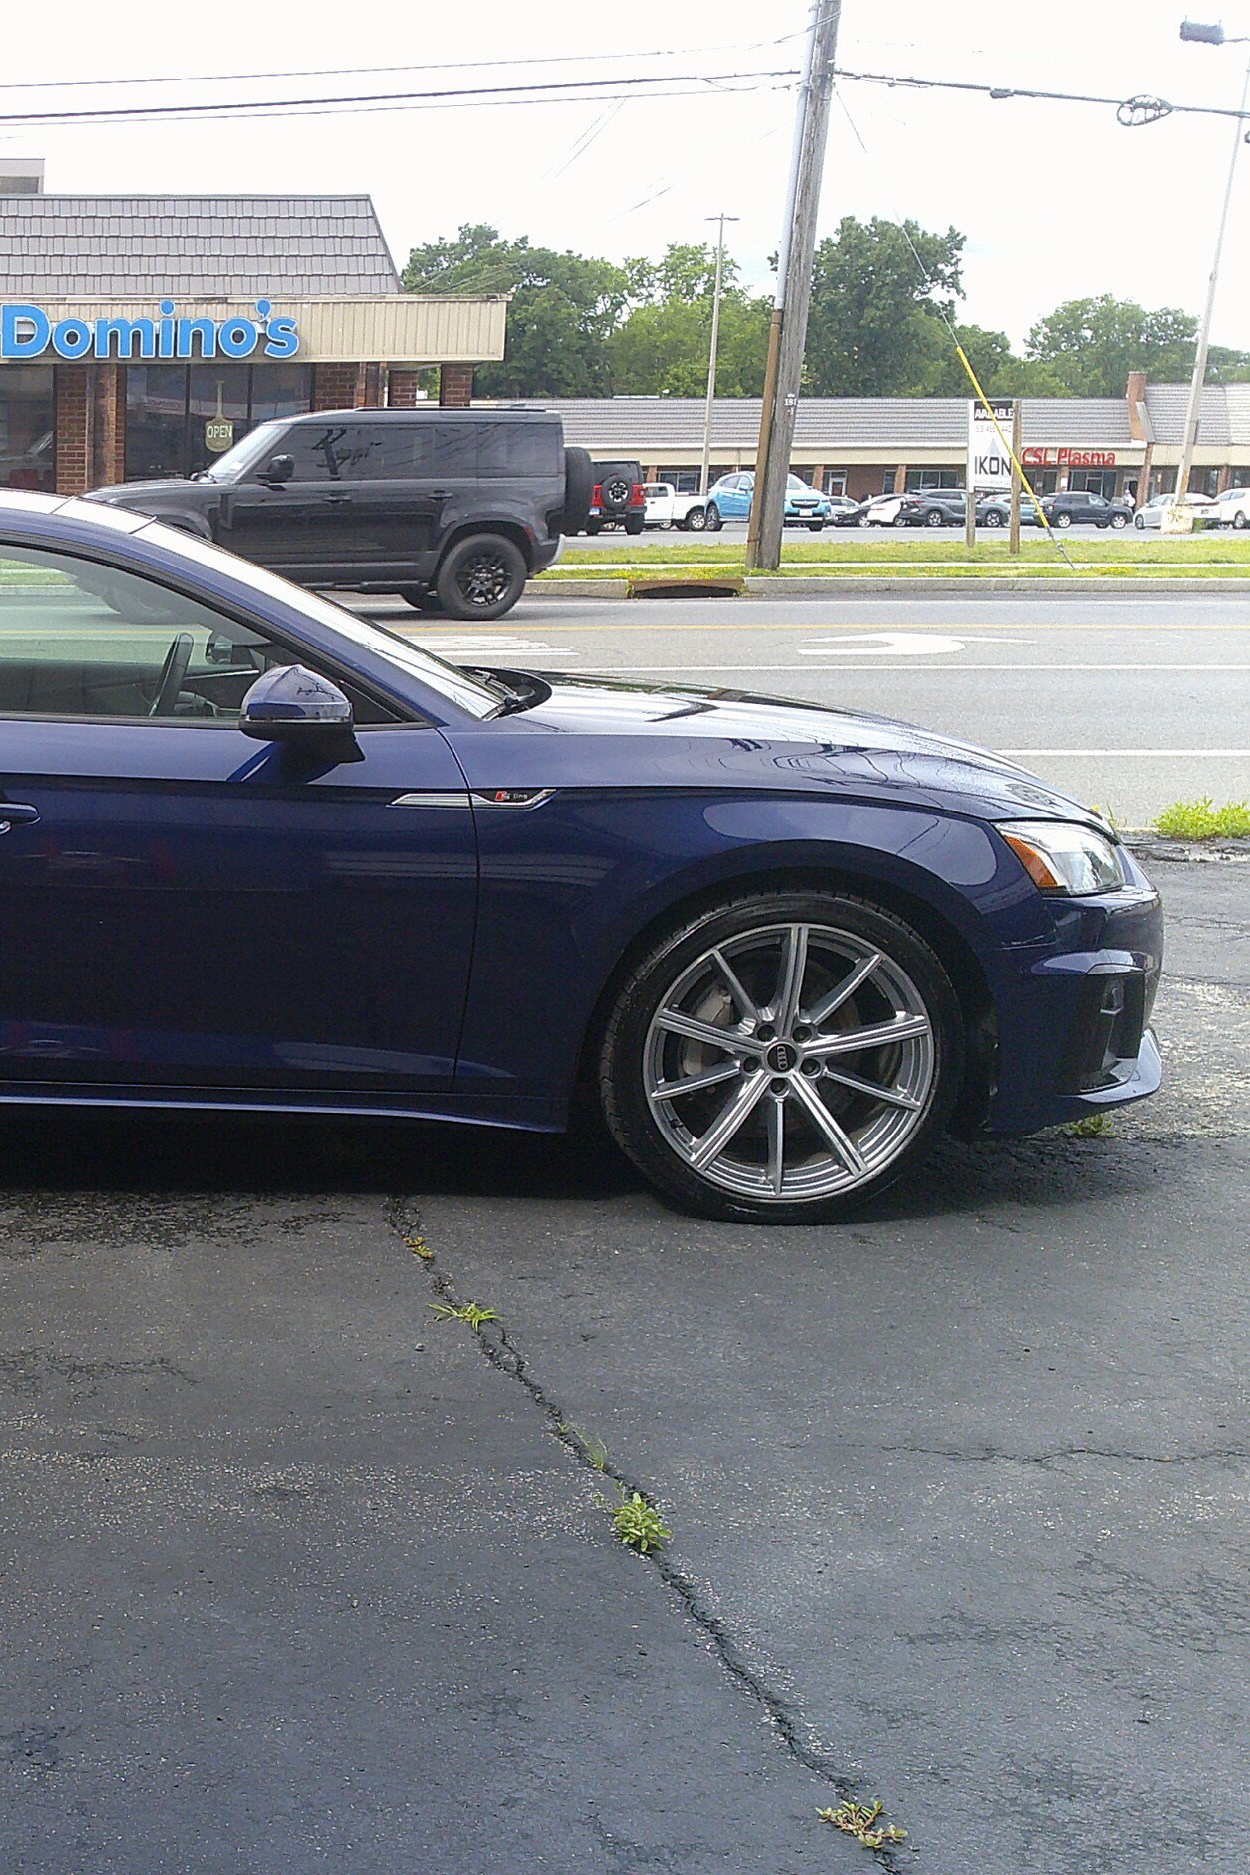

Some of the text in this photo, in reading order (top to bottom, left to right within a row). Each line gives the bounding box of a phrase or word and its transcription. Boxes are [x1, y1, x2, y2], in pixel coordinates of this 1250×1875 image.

[0, 298, 299, 359] Domino's
[207, 425, 232, 438] OPEN
[974, 456, 1012, 476] IKON
[1022, 448, 1116, 466] CSL Plasma
